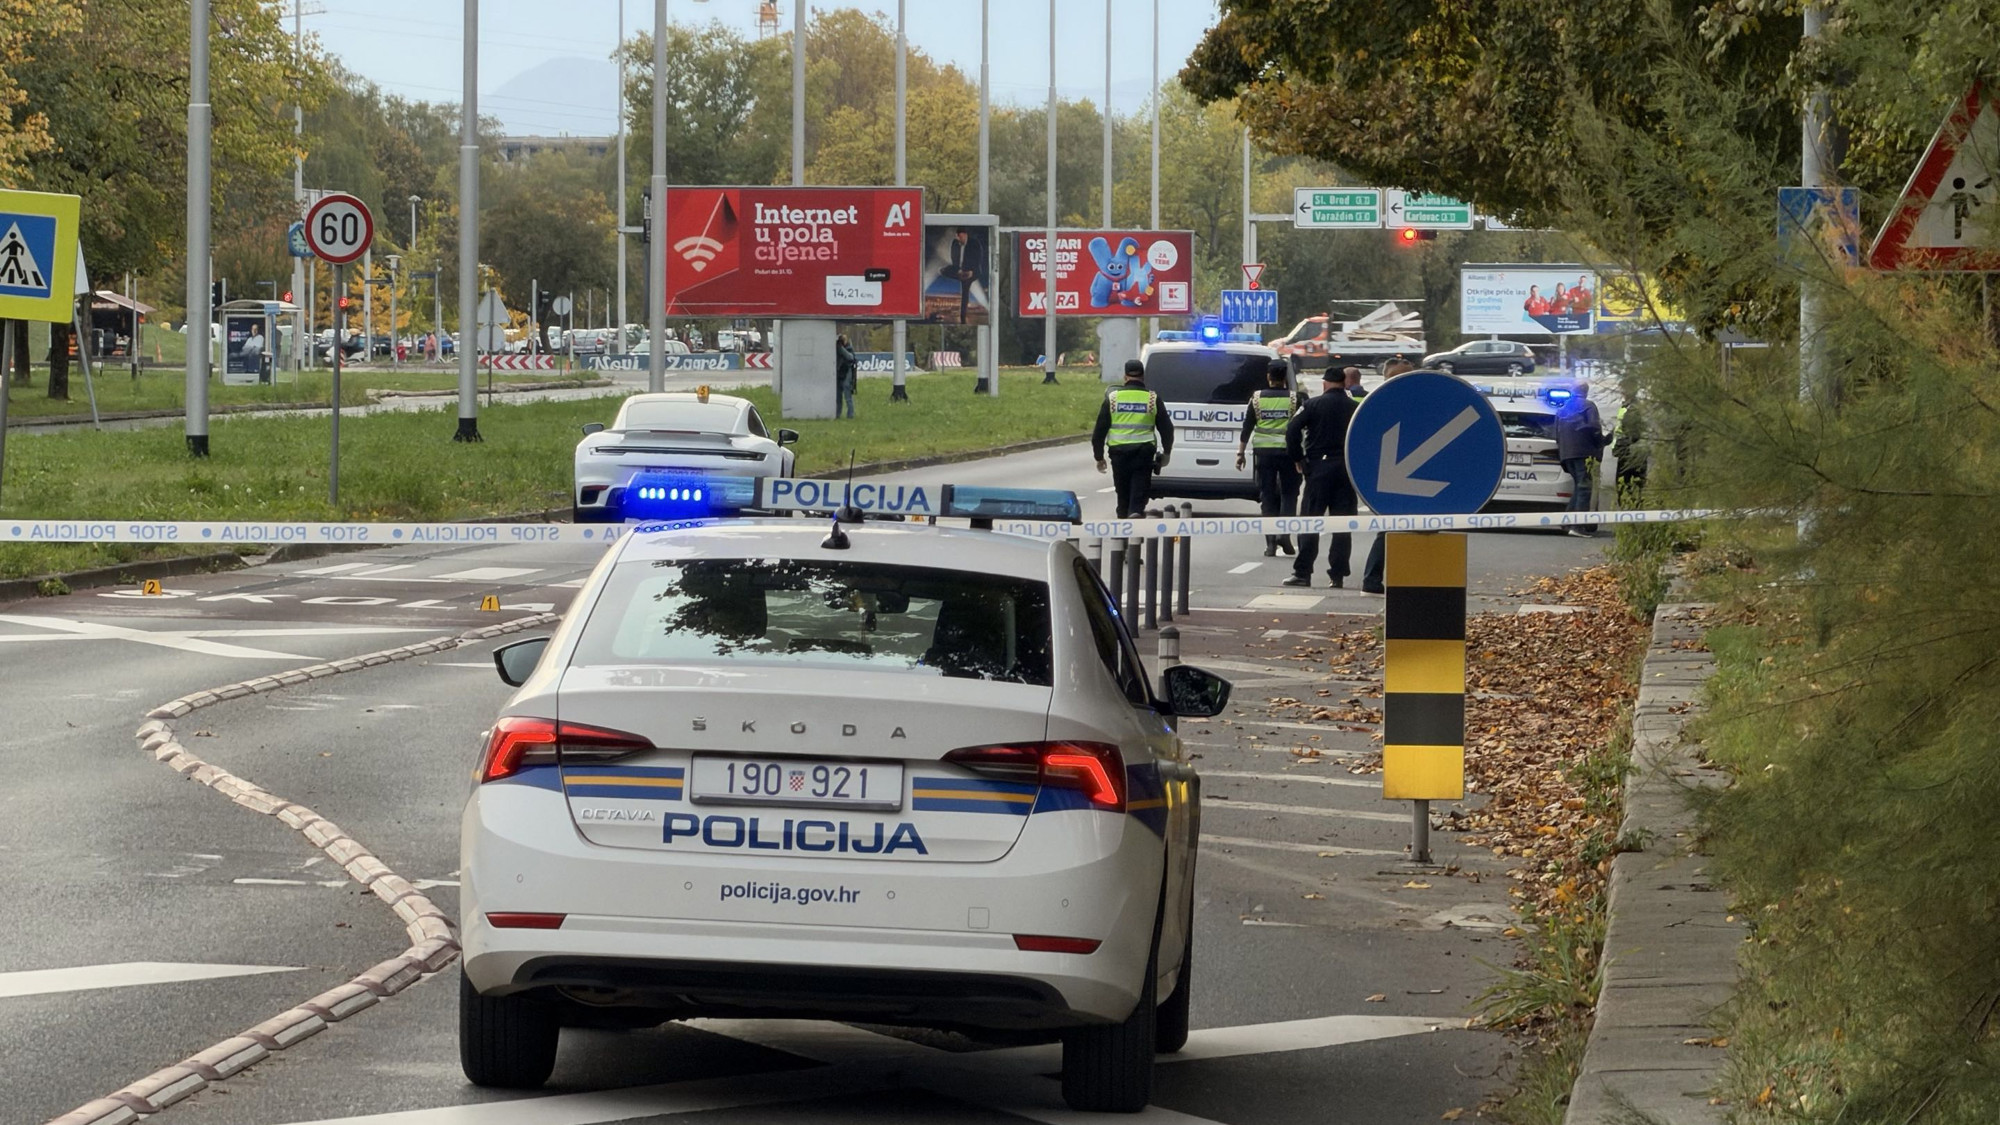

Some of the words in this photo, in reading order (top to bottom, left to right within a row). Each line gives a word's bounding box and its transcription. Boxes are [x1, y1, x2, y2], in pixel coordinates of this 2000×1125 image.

[1329, 195, 1350, 205] Brod
[754, 202, 858, 225] Internet
[884, 200, 911, 228] A1
[1405, 212, 1440, 222] Karlovac
[320, 212, 359, 246] 60
[754, 227, 771, 243] u
[778, 221, 834, 248] pola
[754, 240, 839, 265] cijene!
[1029, 249, 1079, 263] UŠEDE
[832, 288, 859, 299] 14,21
[1496, 288, 1514, 296] priče
[588, 355, 642, 371] Novi
[666, 354, 730, 371] Zagreb
[699, 386, 707, 396] 5
[771, 479, 931, 512] POLICIJA
[147, 581, 156, 594] 2
[486, 597, 493, 609] 1
[691, 716, 907, 740] ŠKODA
[726, 762, 782, 796] 190
[811, 765, 868, 799] 921
[580, 807, 656, 822] OCTAVIA
[661, 811, 930, 856] POLICIJA
[720, 881, 861, 905] policija.gov.hr
